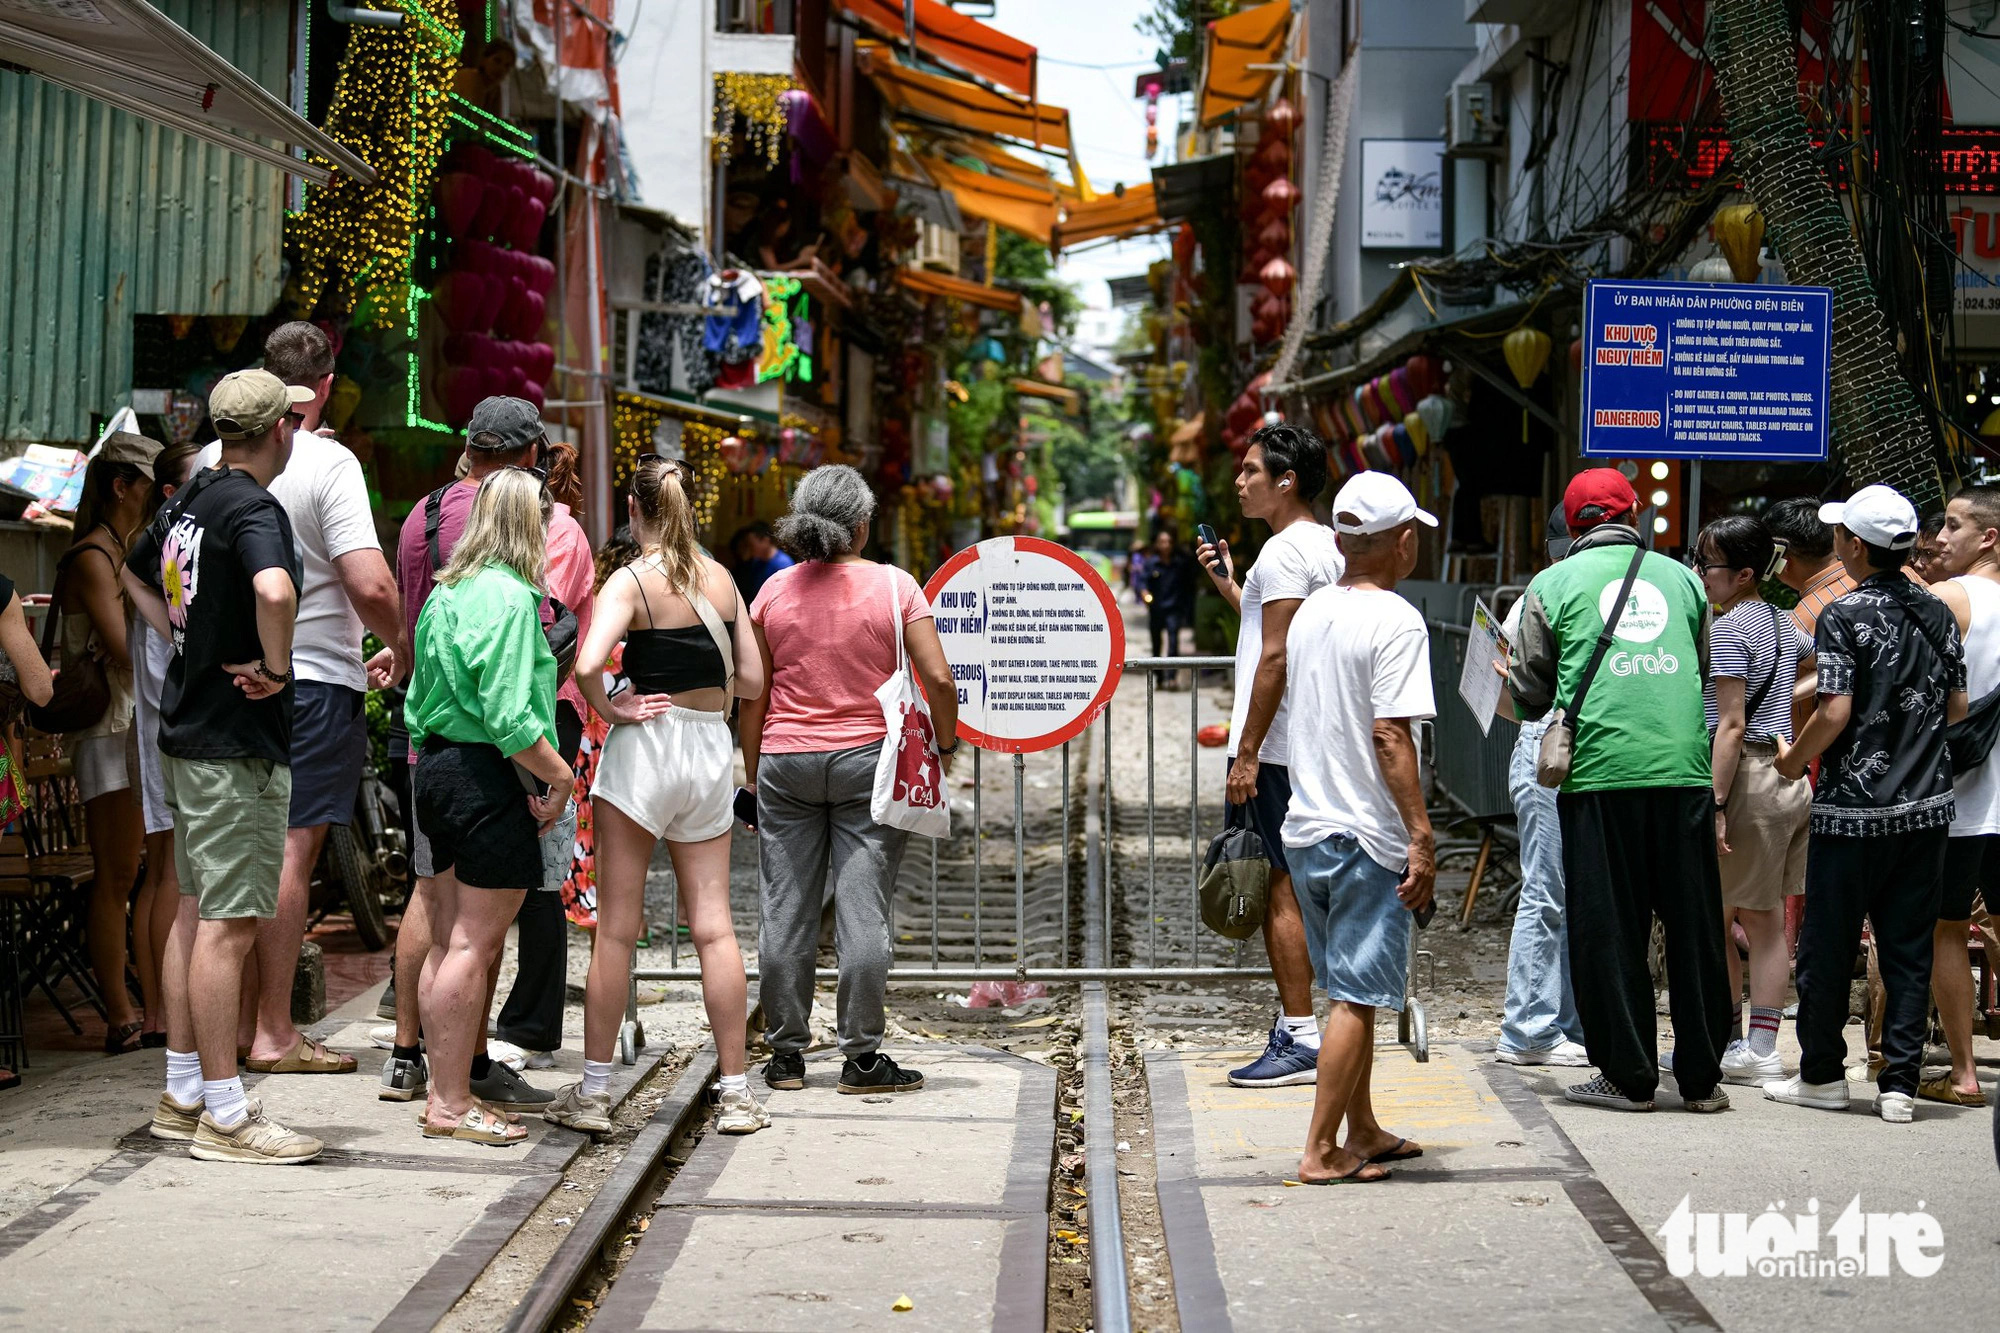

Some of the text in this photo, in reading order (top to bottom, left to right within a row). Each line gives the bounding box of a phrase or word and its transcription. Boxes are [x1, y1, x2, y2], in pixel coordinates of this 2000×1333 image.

[1614, 291, 1804, 313] ỦY BAN NHÂN DÂN PHƯỜNG ĐIỆN BIÊN
[1676, 317, 1695, 328] KHÔNG
[1696, 320, 1704, 331] TỤ
[1705, 318, 1715, 331] TẬP
[1752, 322, 1766, 331] QUAY
[1767, 322, 1784, 332] PHIM,
[1785, 323, 1799, 333] CHỤP
[1605, 325, 1657, 345] KHU VỰC
[1676, 334, 1694, 345] KHÔNG
[1735, 336, 1749, 347] TRÊN
[1597, 345, 1663, 366] NGUY HIỂM
[1675, 351, 1694, 362] KHÔNG
[1754, 353, 1770, 364] HÀNG
[1771, 356, 1788, 365] TRONG
[1674, 365, 1681, 375] VÀ
[1682, 367, 1692, 376] HAI
[1693, 365, 1704, 376] BÊN
[1675, 390, 1813, 402] DO NOT GATHER A CROWD, TAKE PHOTOS, VIDEOS.
[1675, 405, 1813, 416] DO NOT WALK, STAND, SIT ON RAILROAD TRACKS.
[1595, 410, 1660, 427] DANGEROUS
[1673, 420, 1682, 429] DO
[1683, 420, 1695, 429] NOT
[1696, 420, 1720, 429] DISPLAY
[1721, 421, 1744, 430] CHAIRS,
[1746, 421, 1767, 430] TABLES
[1768, 422, 1780, 431] AND
[1804, 423, 1813, 431] ON
[1674, 432, 1762, 441] AND ALONG RAILROAD TRACKS.
[992, 581, 1008, 590] KHÔNG
[1009, 583, 1016, 592] TỤ
[1017, 582, 1025, 592] TẬP
[1058, 583, 1070, 591] QUAY
[941, 591, 977, 612] KHU VỰC
[992, 608, 1008, 617] KHÔNG
[1045, 608, 1057, 617] TRÊN
[936, 611, 982, 633] NGUY HIỂM
[991, 622, 1007, 631] KHÔNG
[1060, 622, 1073, 631] HÀNG
[991, 634, 997, 644] VÀ
[998, 636, 1006, 644] HAI
[1008, 634, 1017, 644] BÊN
[1031, 660, 1048, 668] CROWD,
[1061, 660, 1080, 668] PHOTOS,
[1610, 647, 1678, 676] Grab
[949, 664, 982, 681] GEROUS
[992, 675, 998, 683] DO
[999, 675, 1007, 683] NOT
[1009, 675, 1023, 684] WALK,
[1024, 675, 1040, 684] STAND,
[1049, 675, 1055, 683] ON
[1056, 675, 1078, 683] RAILROAD
[1079, 675, 1097, 683] TRACKS.
[991, 692, 997, 700] DO
[998, 692, 1007, 700] NOT
[1008, 692, 1026, 700] DISPLAY
[1027, 692, 1045, 701] CHAIRS,
[1046, 692, 1062, 700] TABLES
[1063, 692, 1073, 700] AND
[992, 702, 1066, 711] ON AND ALONG RAILROAD TRACKS.
[910, 785, 934, 806] C&A
